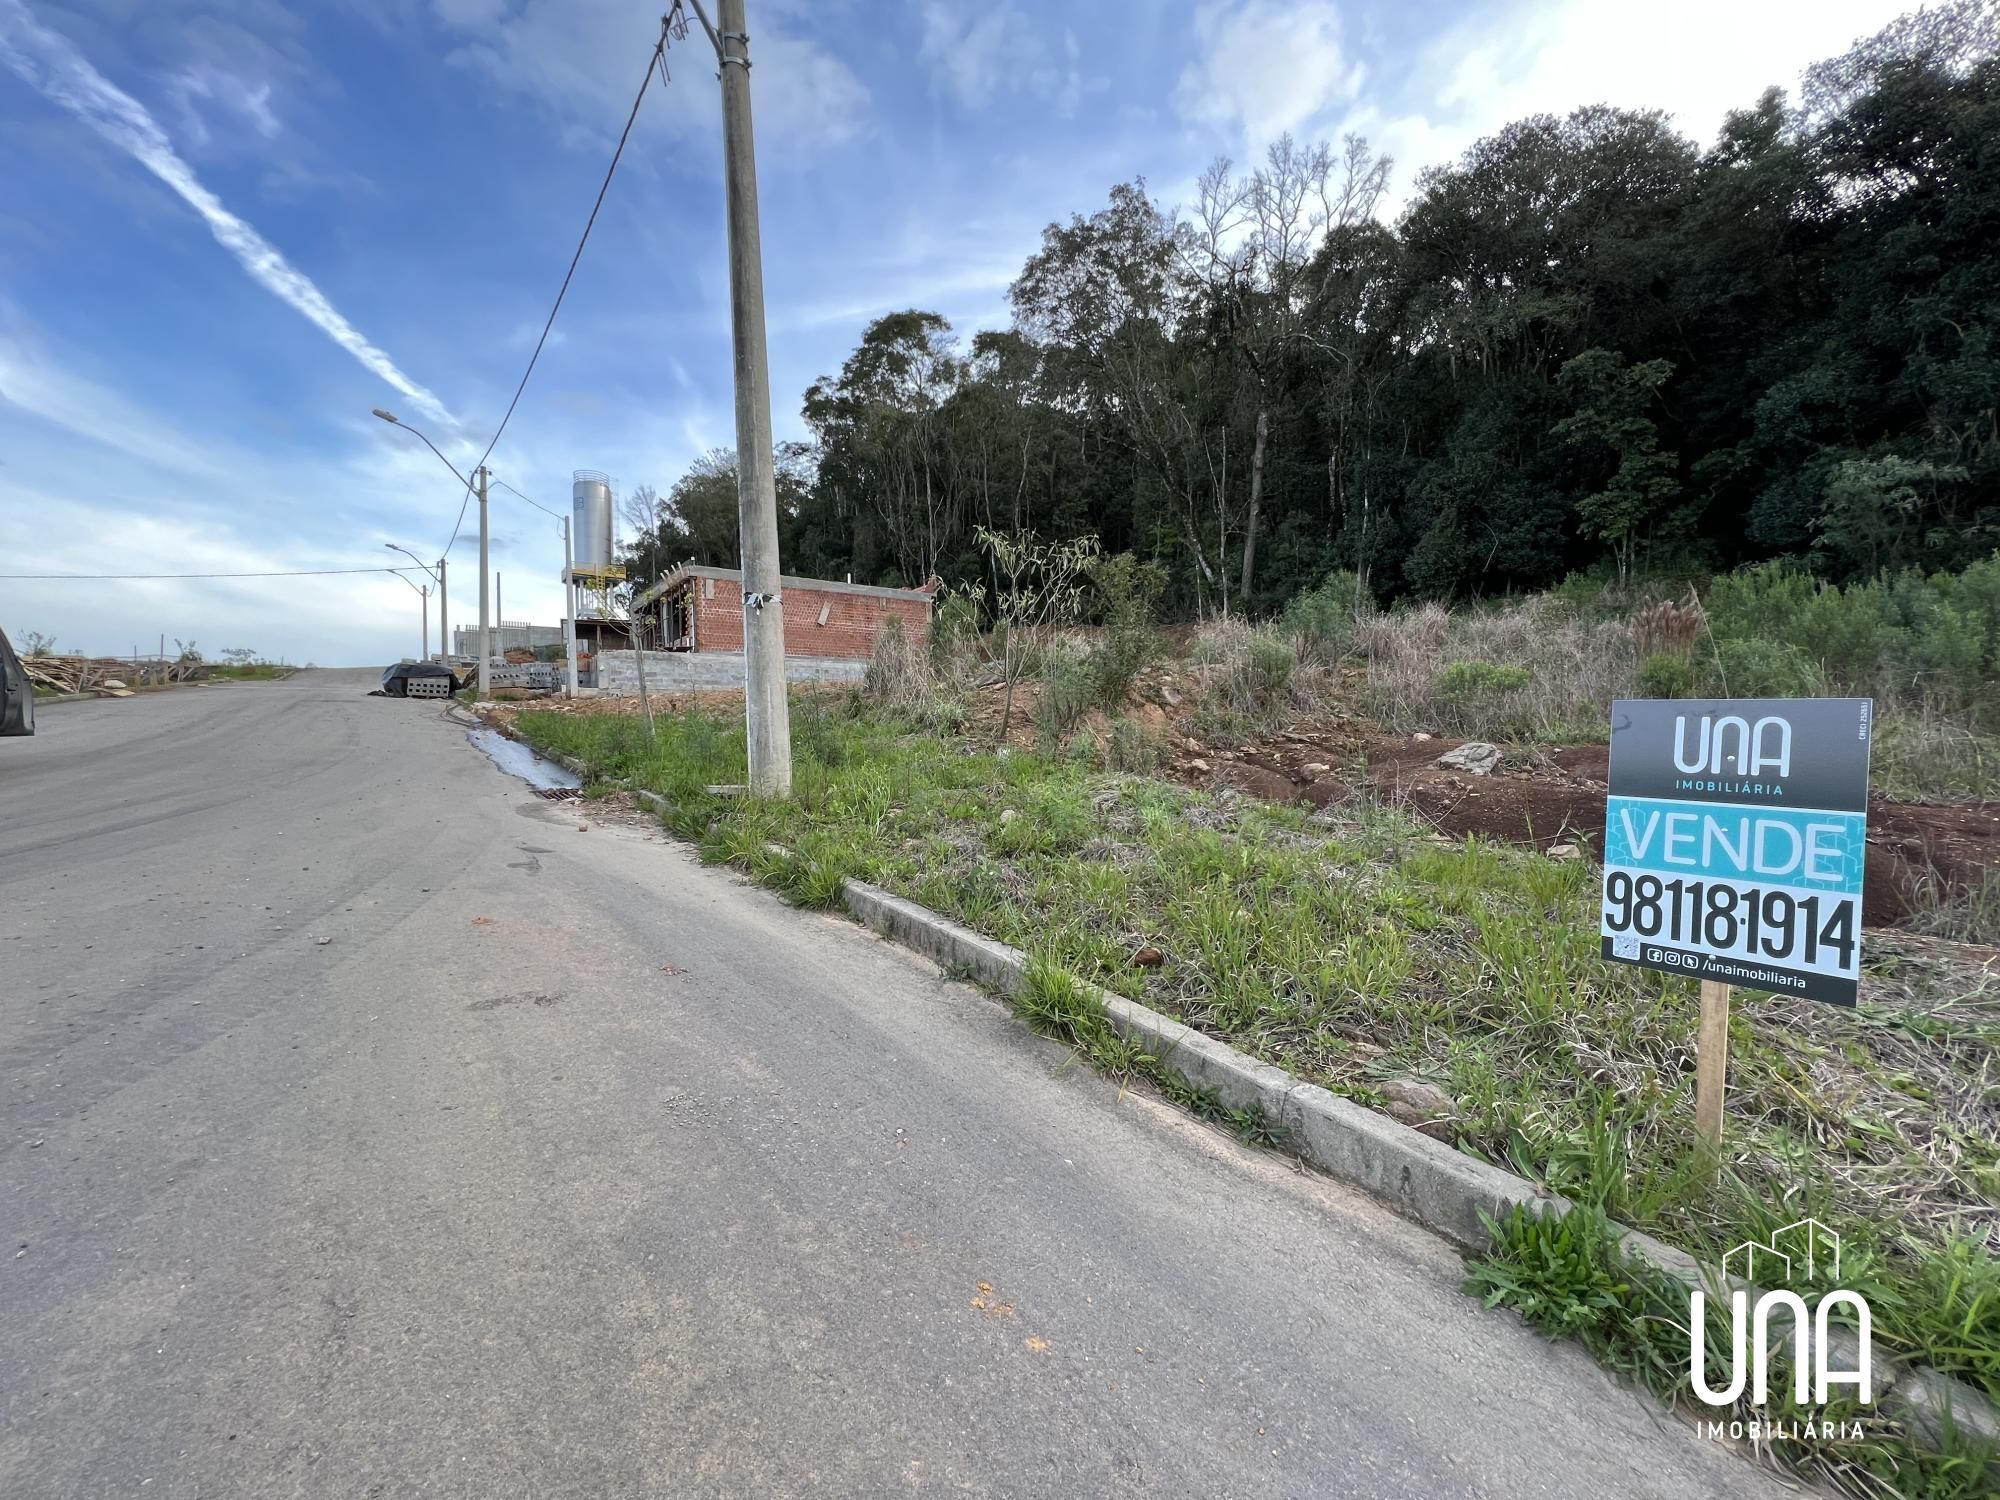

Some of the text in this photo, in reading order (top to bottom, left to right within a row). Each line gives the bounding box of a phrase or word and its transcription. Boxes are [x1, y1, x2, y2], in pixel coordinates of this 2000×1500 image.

[1674, 716, 1791, 777] UNA
[1676, 780, 1783, 795] IMOBILIÁRIA
[1620, 808, 1846, 882] VENDE
[1702, 959, 1806, 989] /unaimobiliaria
